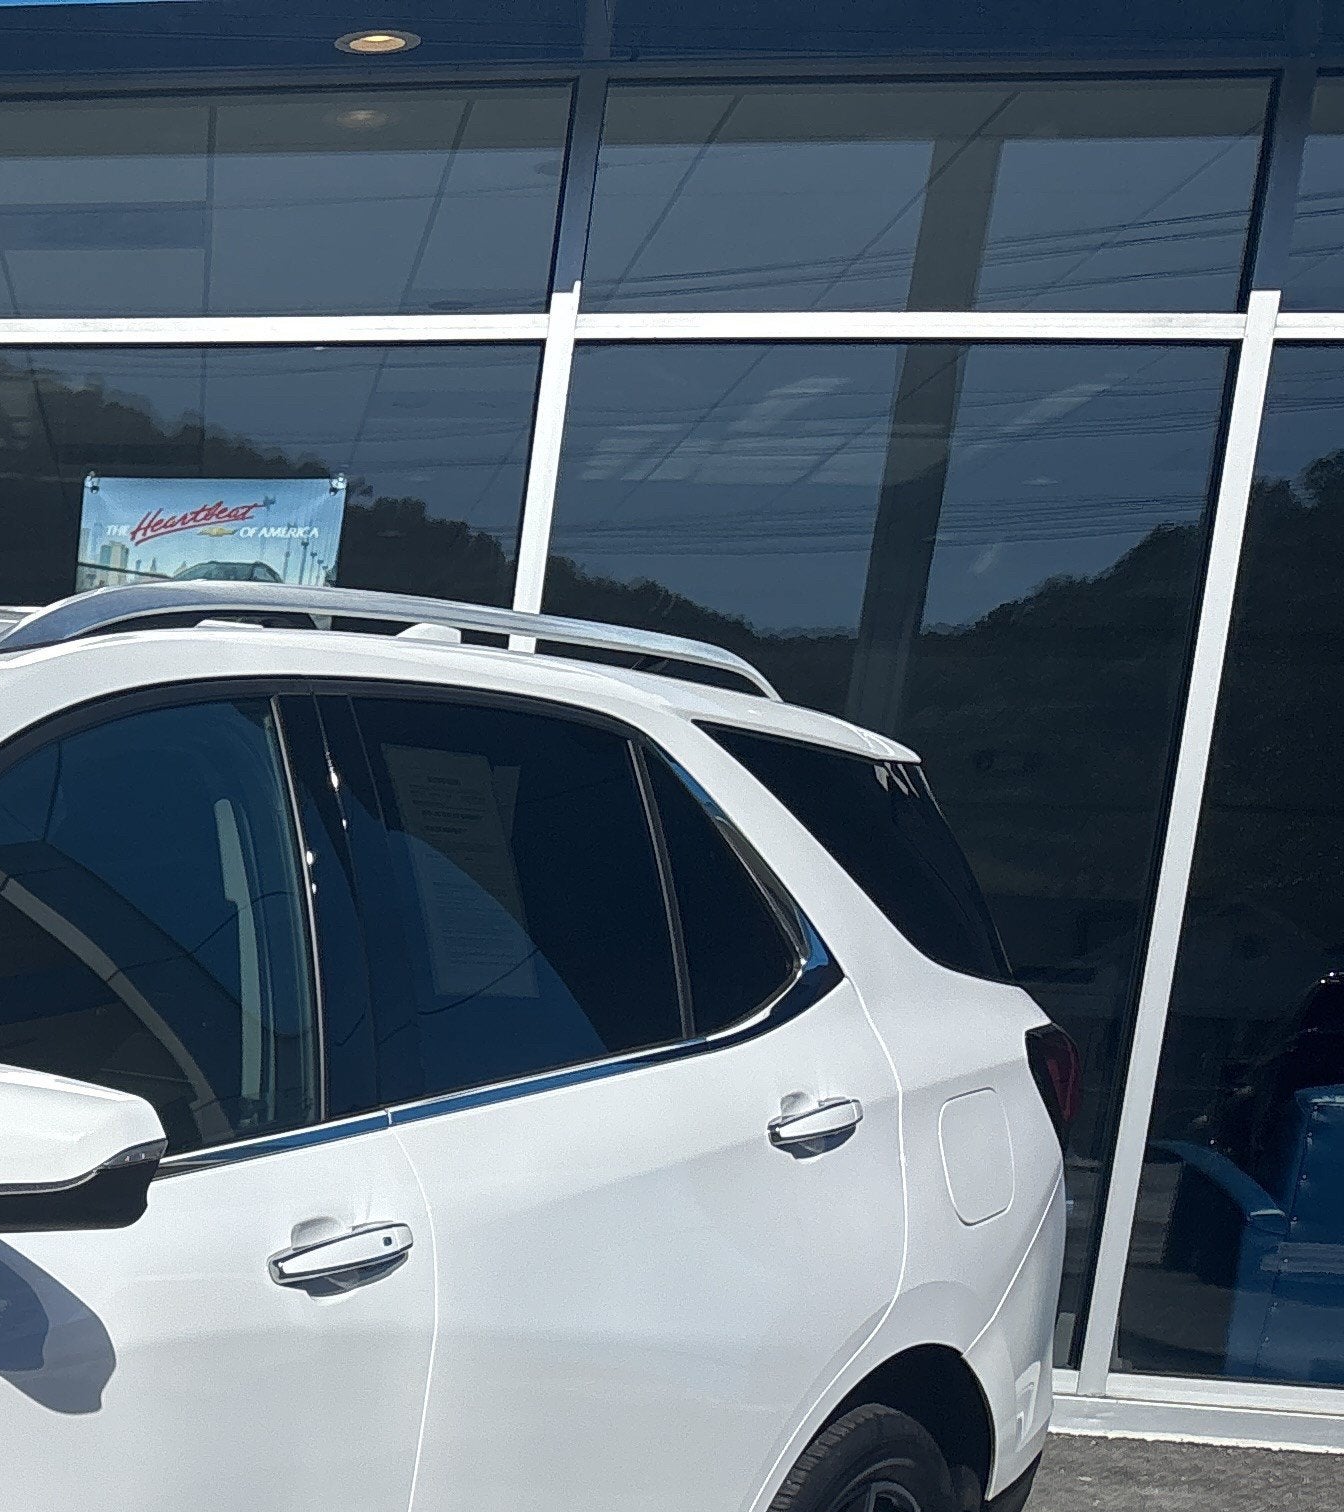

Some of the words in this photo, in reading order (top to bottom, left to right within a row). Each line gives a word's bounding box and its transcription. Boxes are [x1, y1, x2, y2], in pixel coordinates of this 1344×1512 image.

[106, 524, 130, 536] THE
[239, 526, 256, 538] OF
[257, 526, 319, 538] AMERICA
[130, 501, 262, 546] Heartbeat
